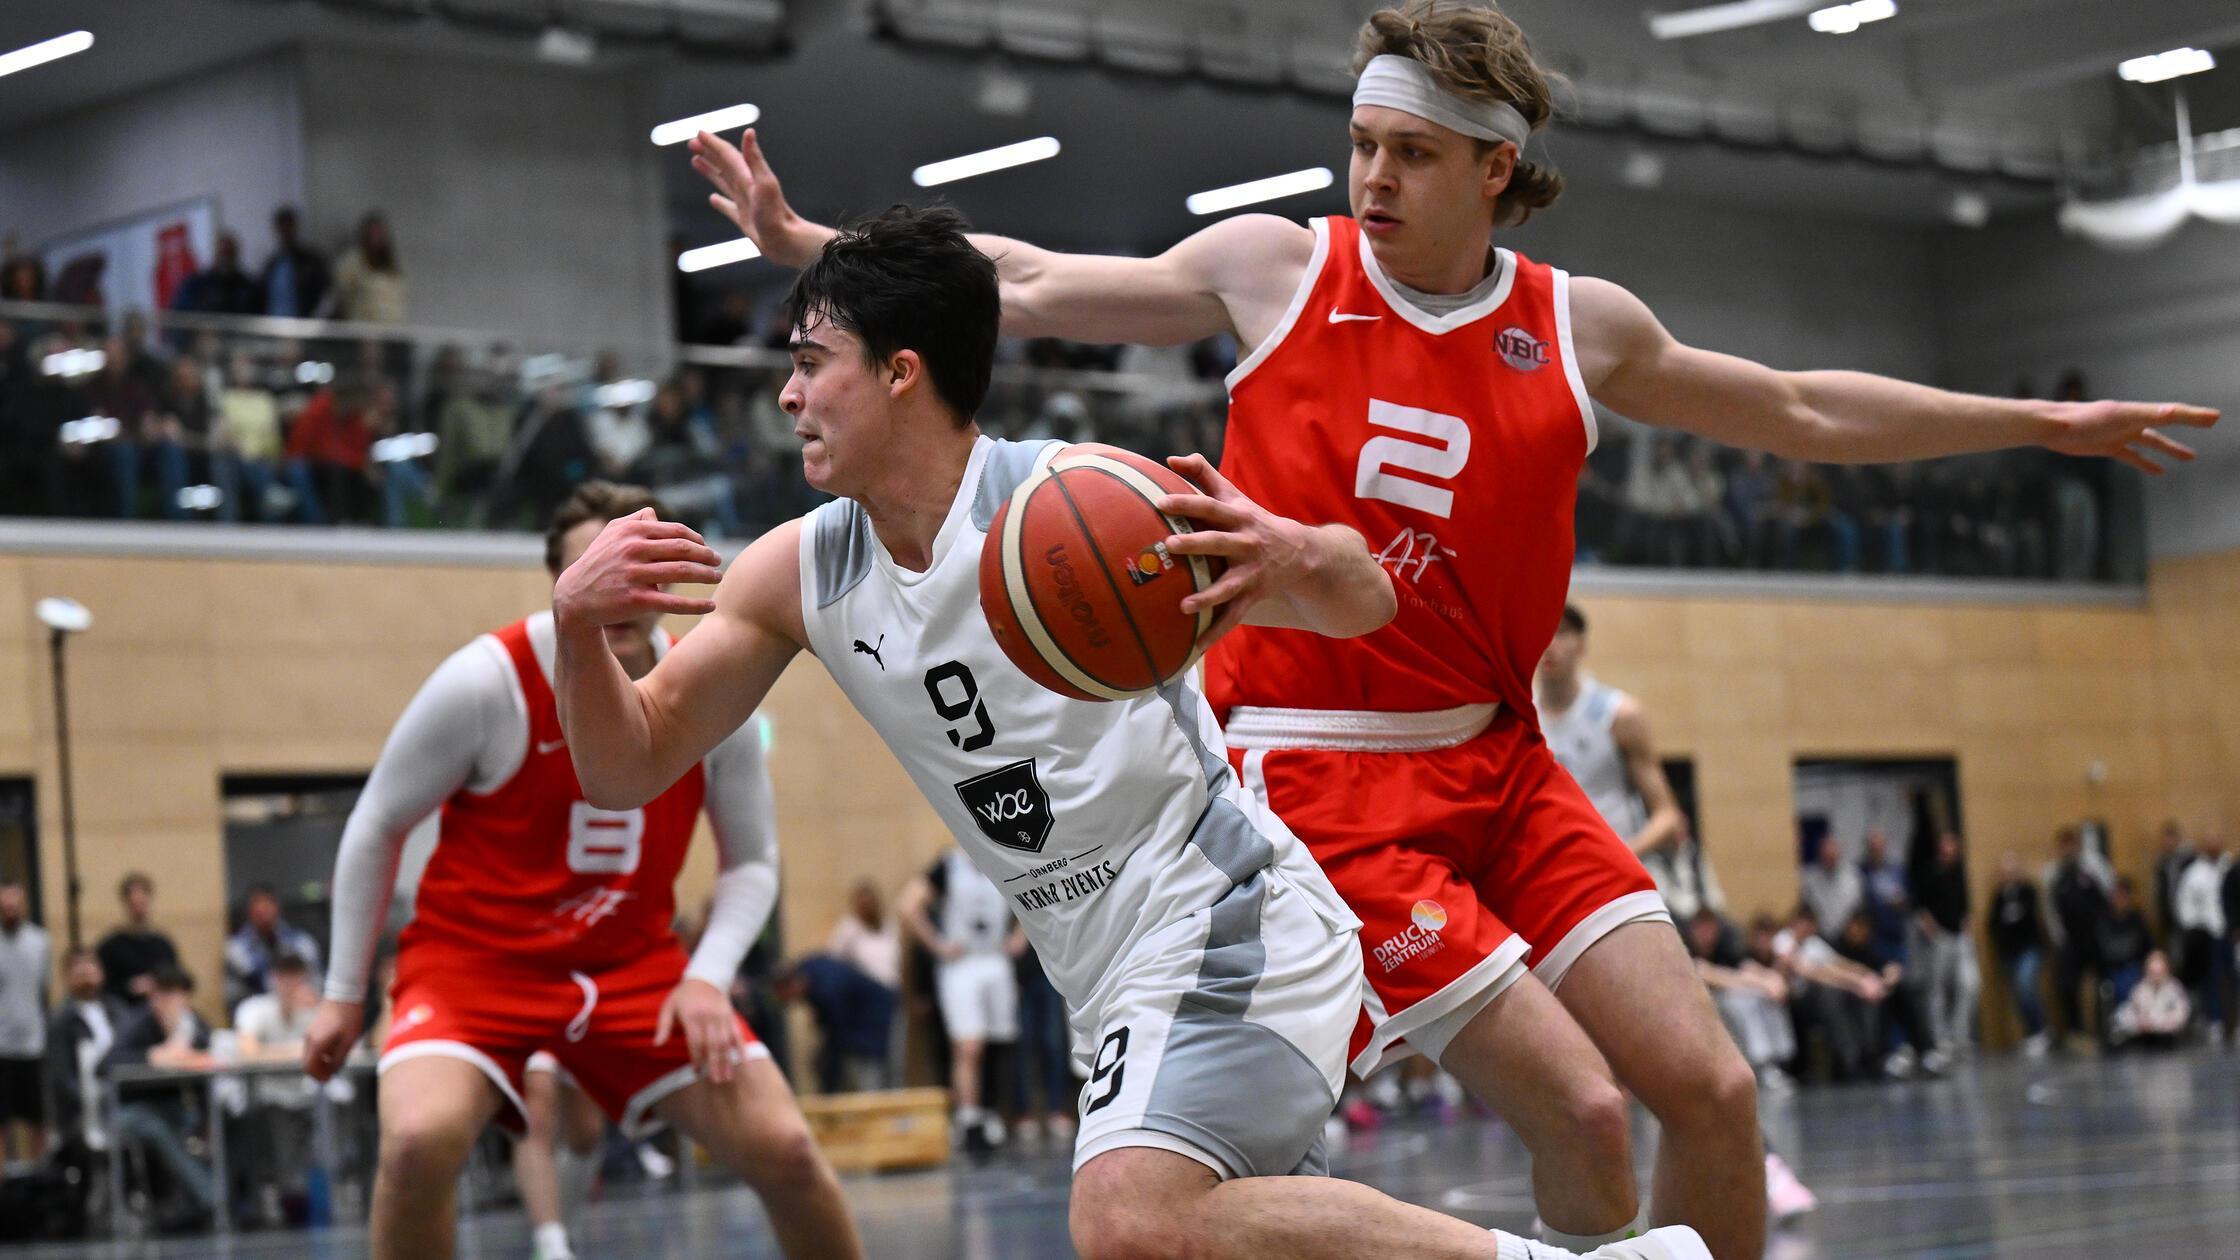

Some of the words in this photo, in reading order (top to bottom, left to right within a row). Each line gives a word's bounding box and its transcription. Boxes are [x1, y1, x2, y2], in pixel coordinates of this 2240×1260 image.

[1492, 327, 1550, 364] NBC
[1355, 398, 1472, 519] 2
[923, 660, 996, 752] 9
[566, 800, 646, 875] 8
[976, 788, 1034, 825] wbe
[1014, 882, 1061, 912] WERNR
[1061, 860, 1117, 901] EVENTS
[1382, 931, 1441, 973] ZENTRUM
[1085, 1025, 1130, 1116] 9
